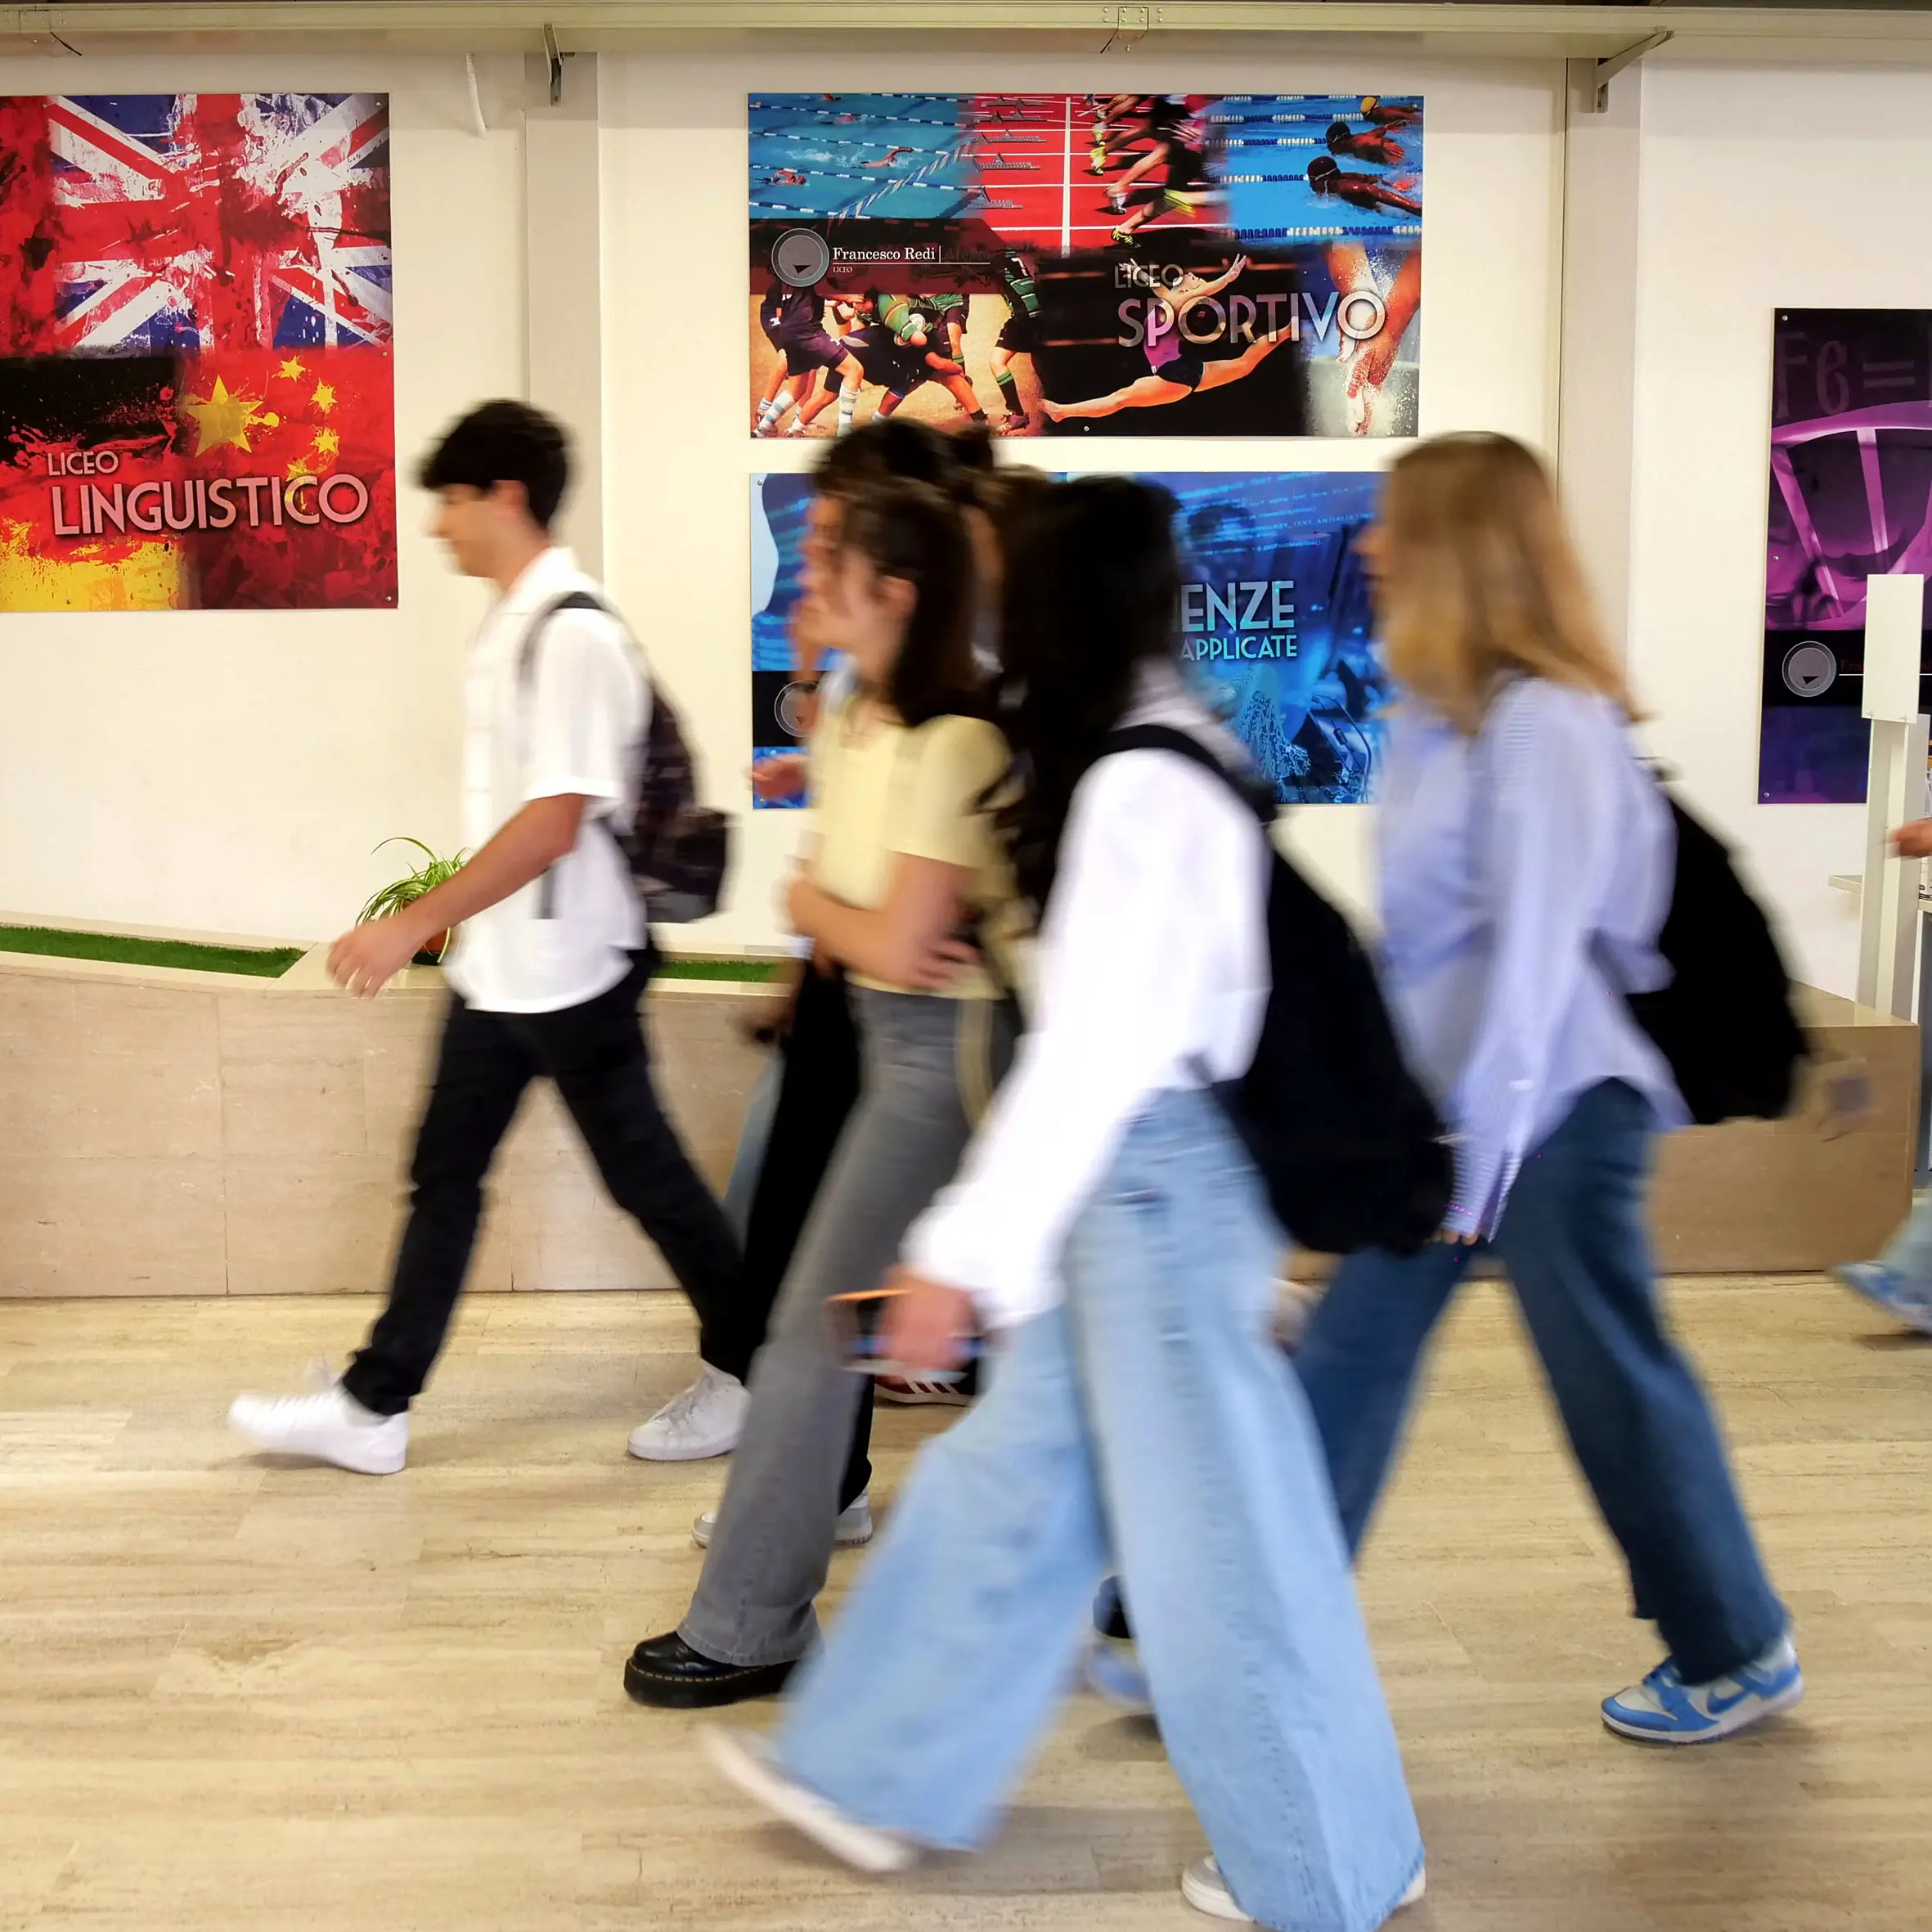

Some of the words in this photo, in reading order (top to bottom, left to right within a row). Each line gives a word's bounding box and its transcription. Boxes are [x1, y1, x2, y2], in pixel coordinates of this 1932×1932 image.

[833, 247, 901, 260] Francesco
[904, 247, 936, 260] Redi
[1115, 263, 1184, 289] LICEO
[1117, 290, 1386, 348] SPORTIVO
[47, 451, 119, 476] LICEO
[52, 474, 368, 536] LINGUISTICO
[1180, 635, 1298, 661] APPLICATE
